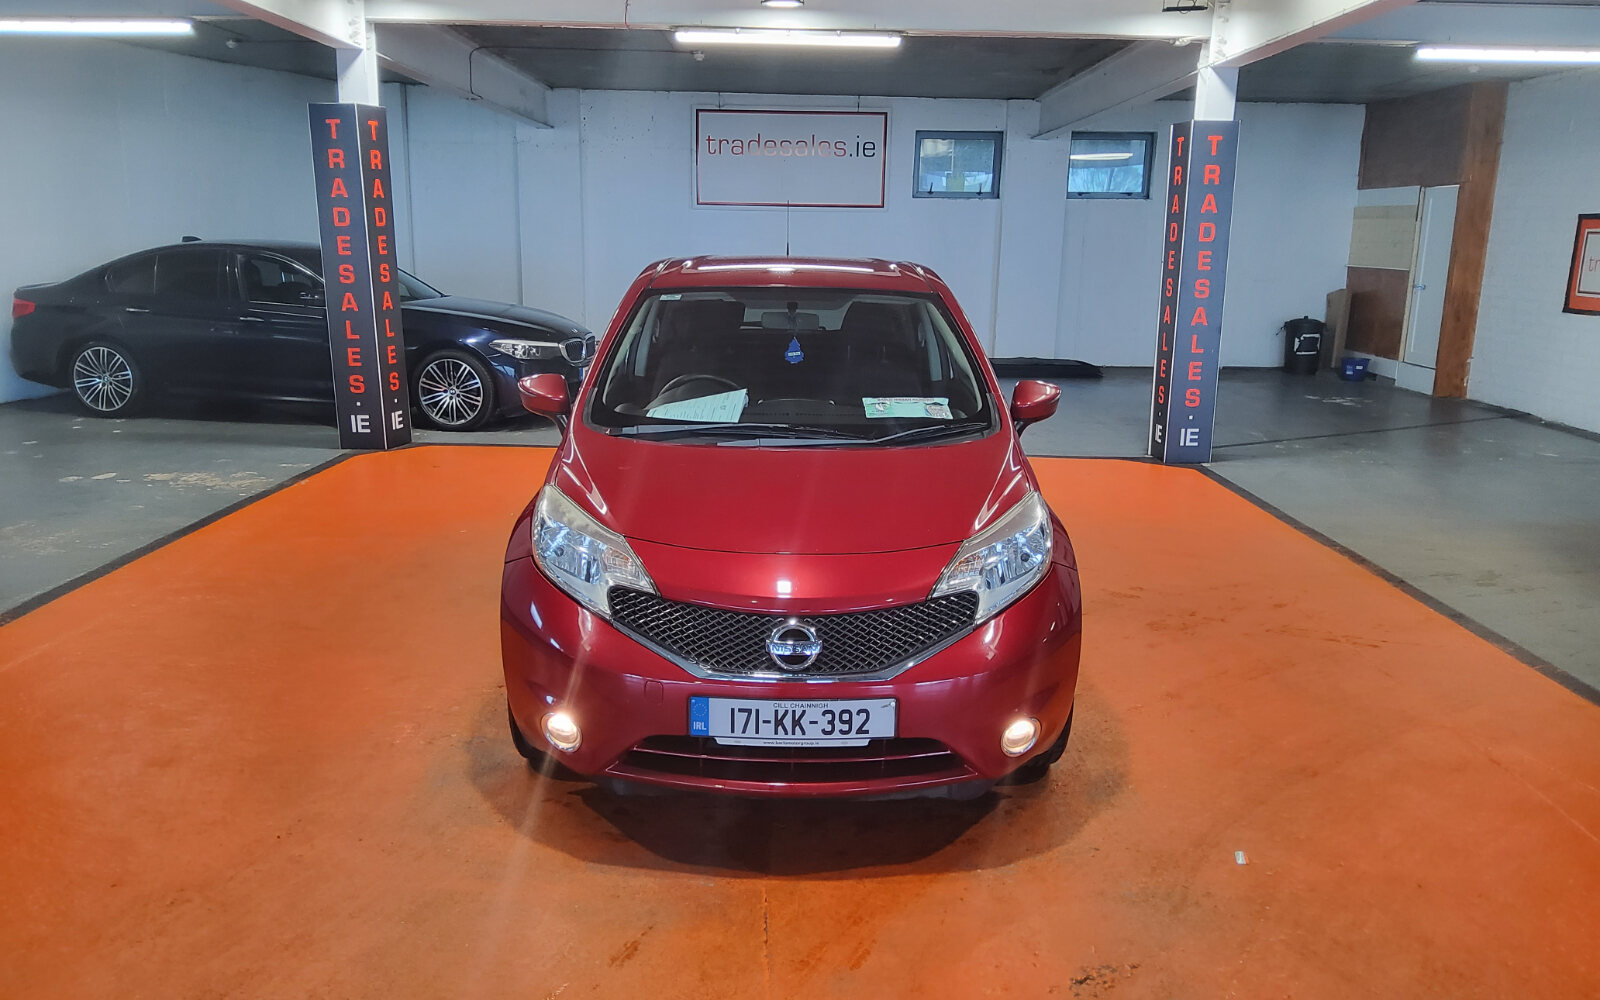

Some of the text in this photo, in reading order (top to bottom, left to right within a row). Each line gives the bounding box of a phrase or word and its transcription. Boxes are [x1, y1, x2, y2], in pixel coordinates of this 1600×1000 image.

[705, 133, 876, 158] tradesales.ie
[771, 644, 818, 653] NISSAN
[693, 721, 707, 731] IRL
[730, 708, 870, 736] 171-KK-392
